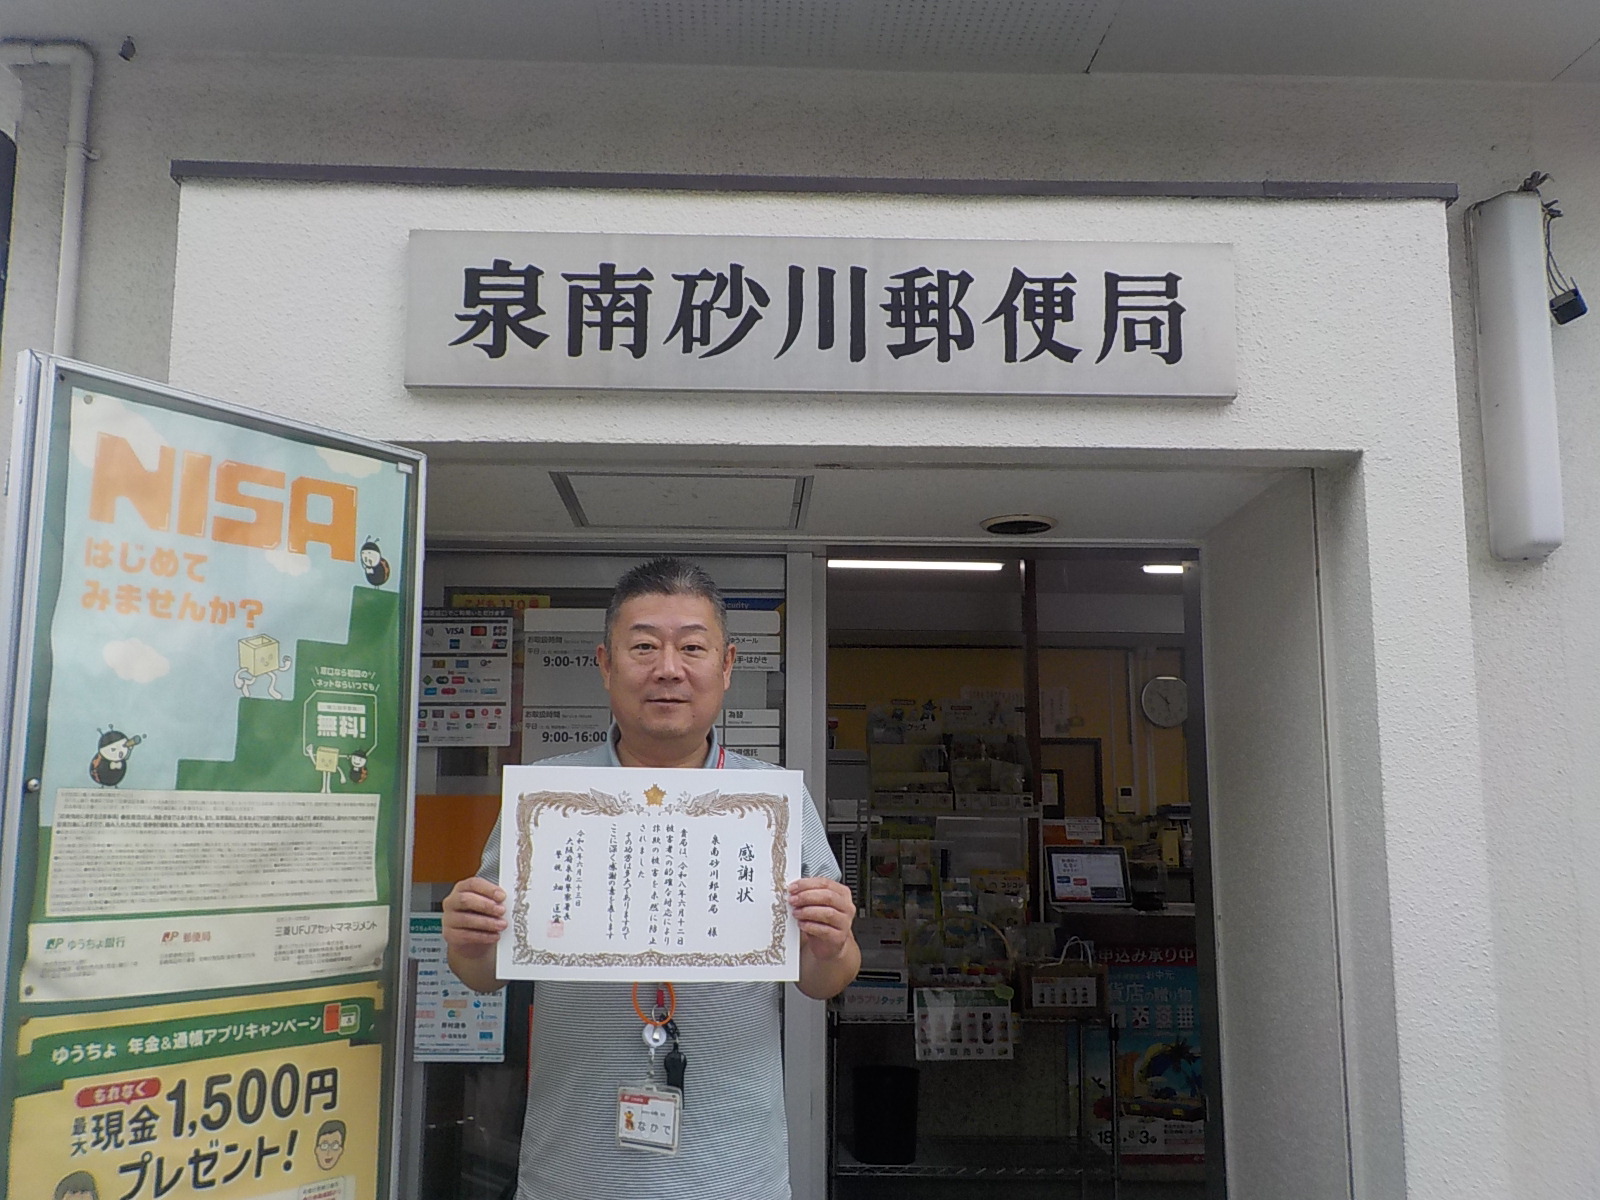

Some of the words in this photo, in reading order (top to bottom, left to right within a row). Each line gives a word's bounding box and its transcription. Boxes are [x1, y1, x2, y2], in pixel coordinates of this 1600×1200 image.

[448, 260, 1187, 364] 泉南砂川郵便局
[89, 432, 358, 562] NISA
[84, 536, 208, 583] はじめて
[81, 580, 264, 629] みませんか?
[543, 656, 600, 667] 9:00-17:0
[734, 655, 768, 664] 手・はがき
[317, 714, 366, 738] 無料!
[542, 731, 607, 742] 9:00-16:00
[708, 834, 720, 914] 泉南砂川郵便局
[736, 843, 755, 903] 感謝状
[707, 926, 718, 938] 様
[52, 1042, 117, 1066] ゆうちょ
[128, 1016, 321, 1054] 年金&通帳アプリキャンペーン
[94, 1080, 147, 1103] もれなく
[71, 1116, 87, 1157] 最大
[118, 1129, 299, 1200] プレゼント!
